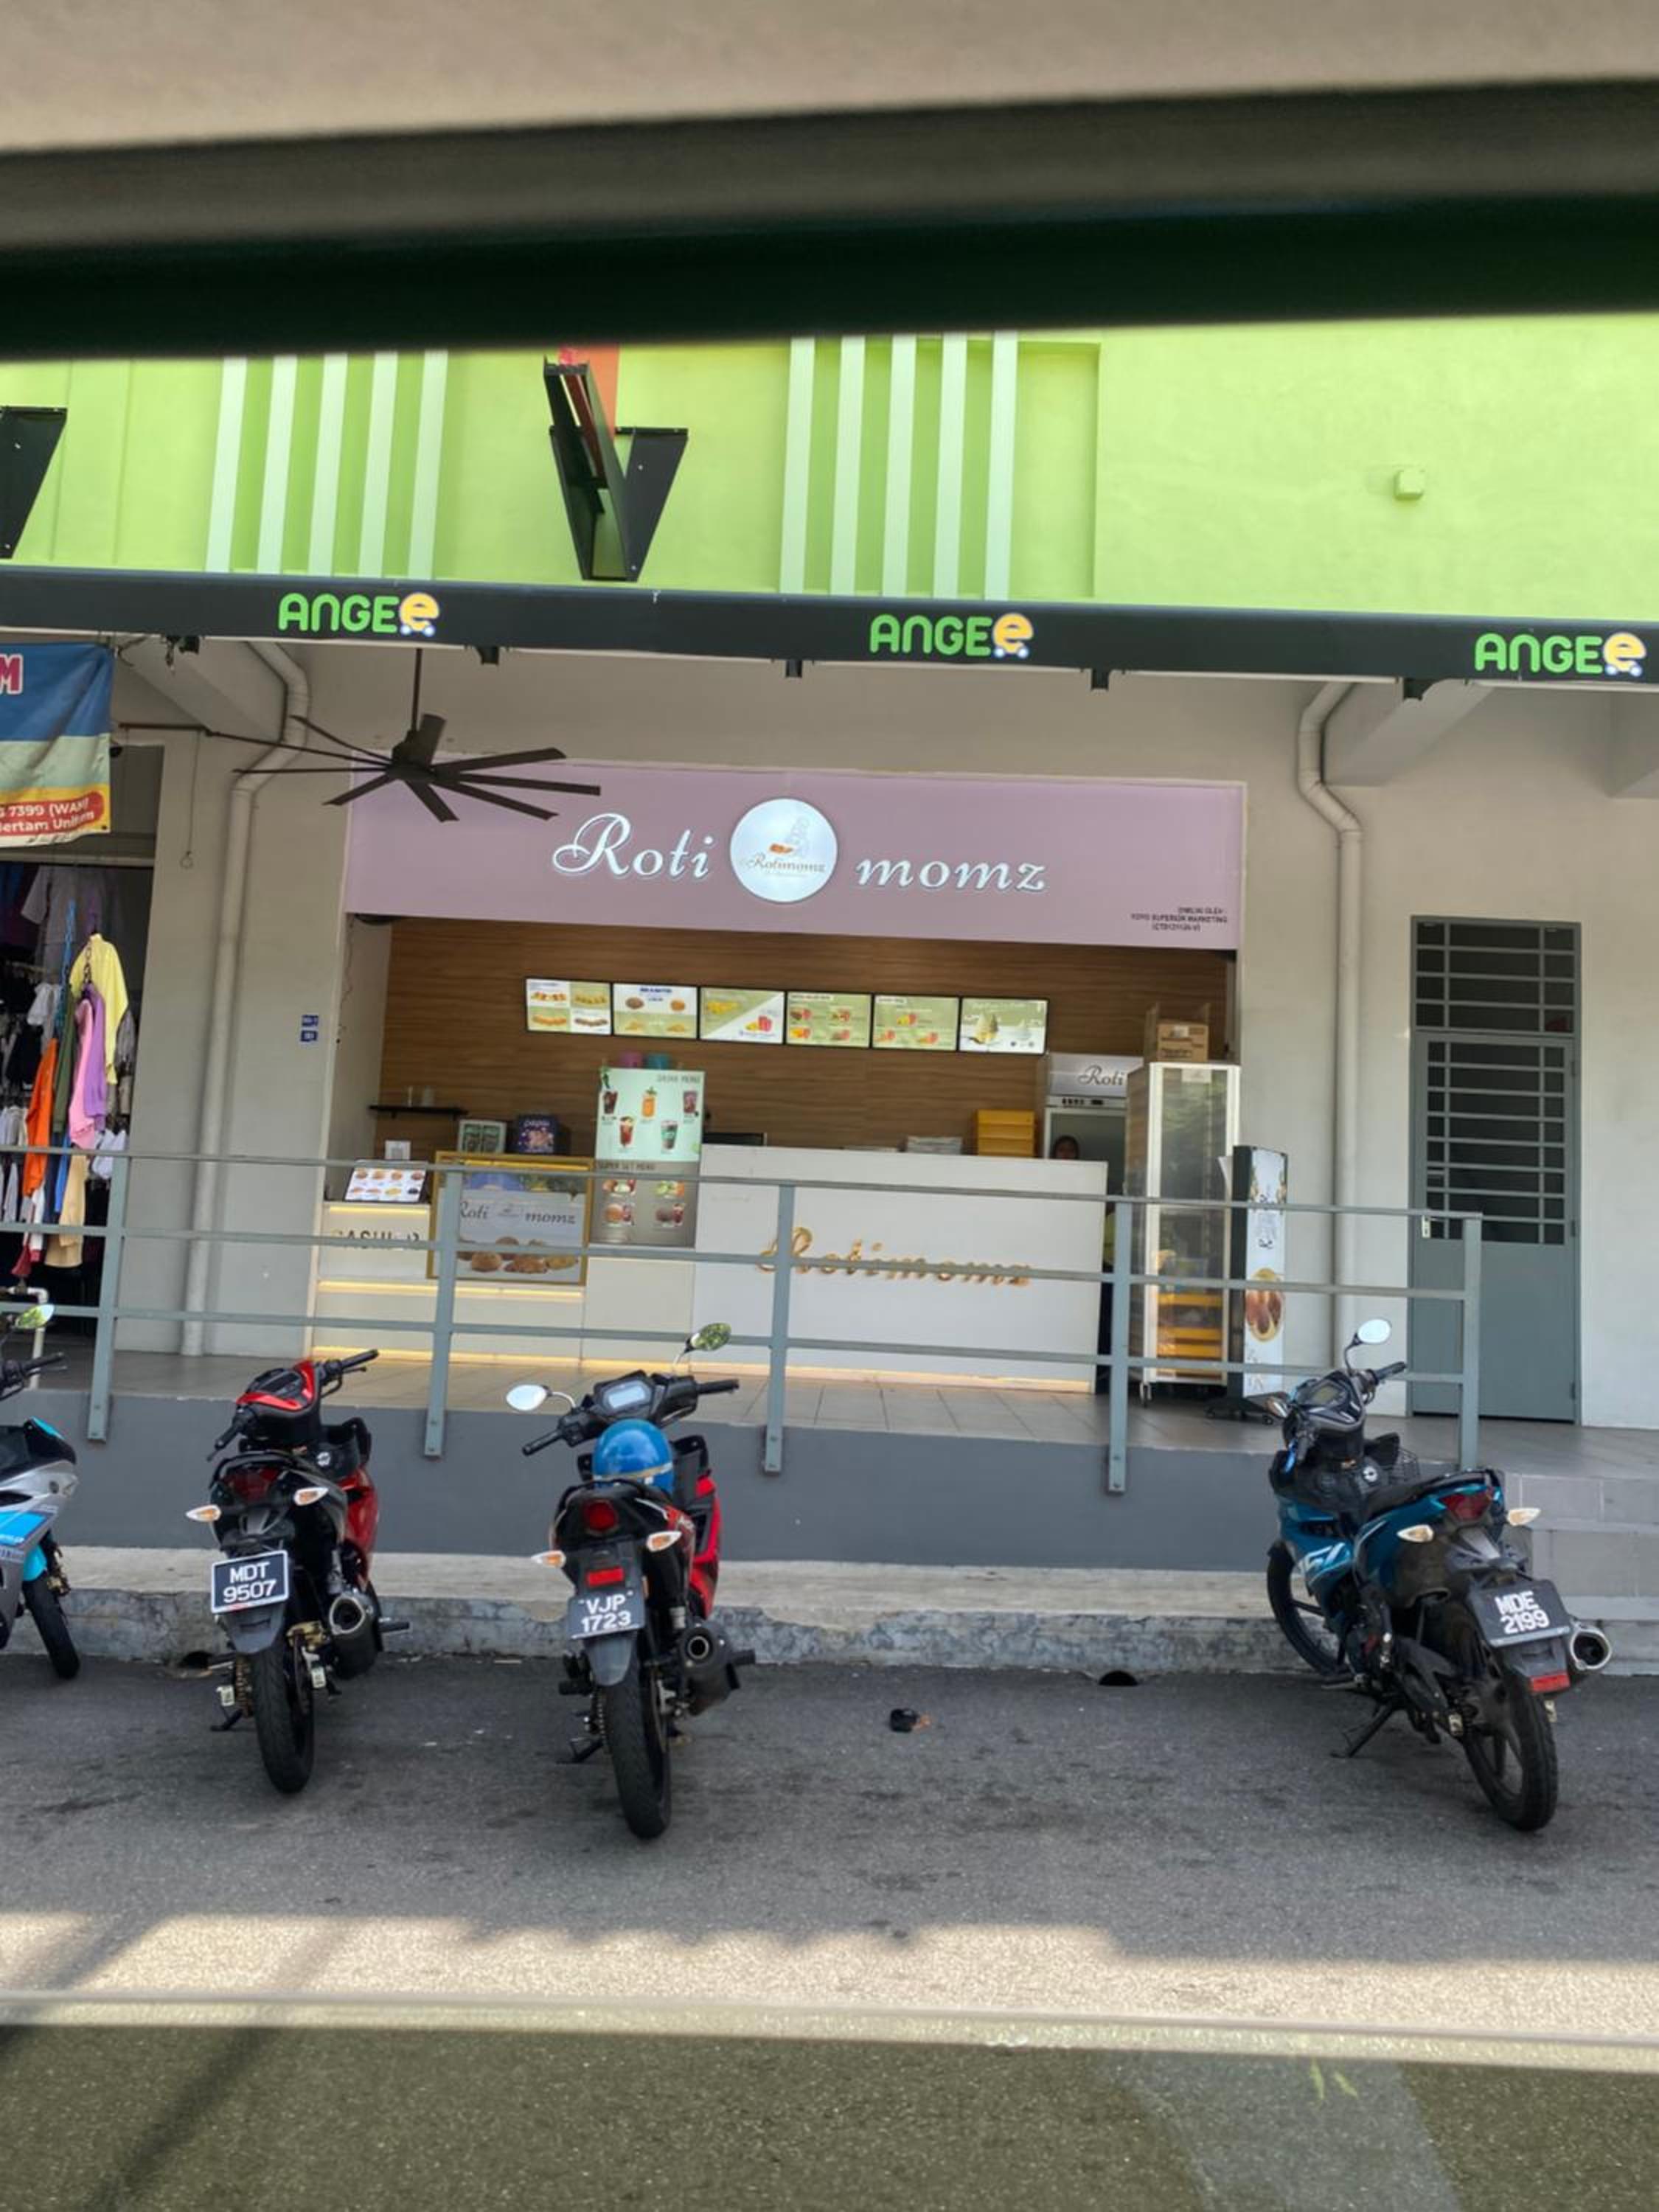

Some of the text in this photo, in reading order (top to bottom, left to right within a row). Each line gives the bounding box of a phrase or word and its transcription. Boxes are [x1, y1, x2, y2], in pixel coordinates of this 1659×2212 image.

[552, 813, 1046, 891] Roti momz
[1078, 1065, 1124, 1085] Roti
[525, 1211, 575, 1225] momz
[229, 1561, 270, 1583] MDT
[223, 1580, 277, 1603] 9507
[585, 1593, 626, 1614] VJP
[581, 1610, 631, 1632] 1723
[1500, 1610, 1550, 1634] 2199
